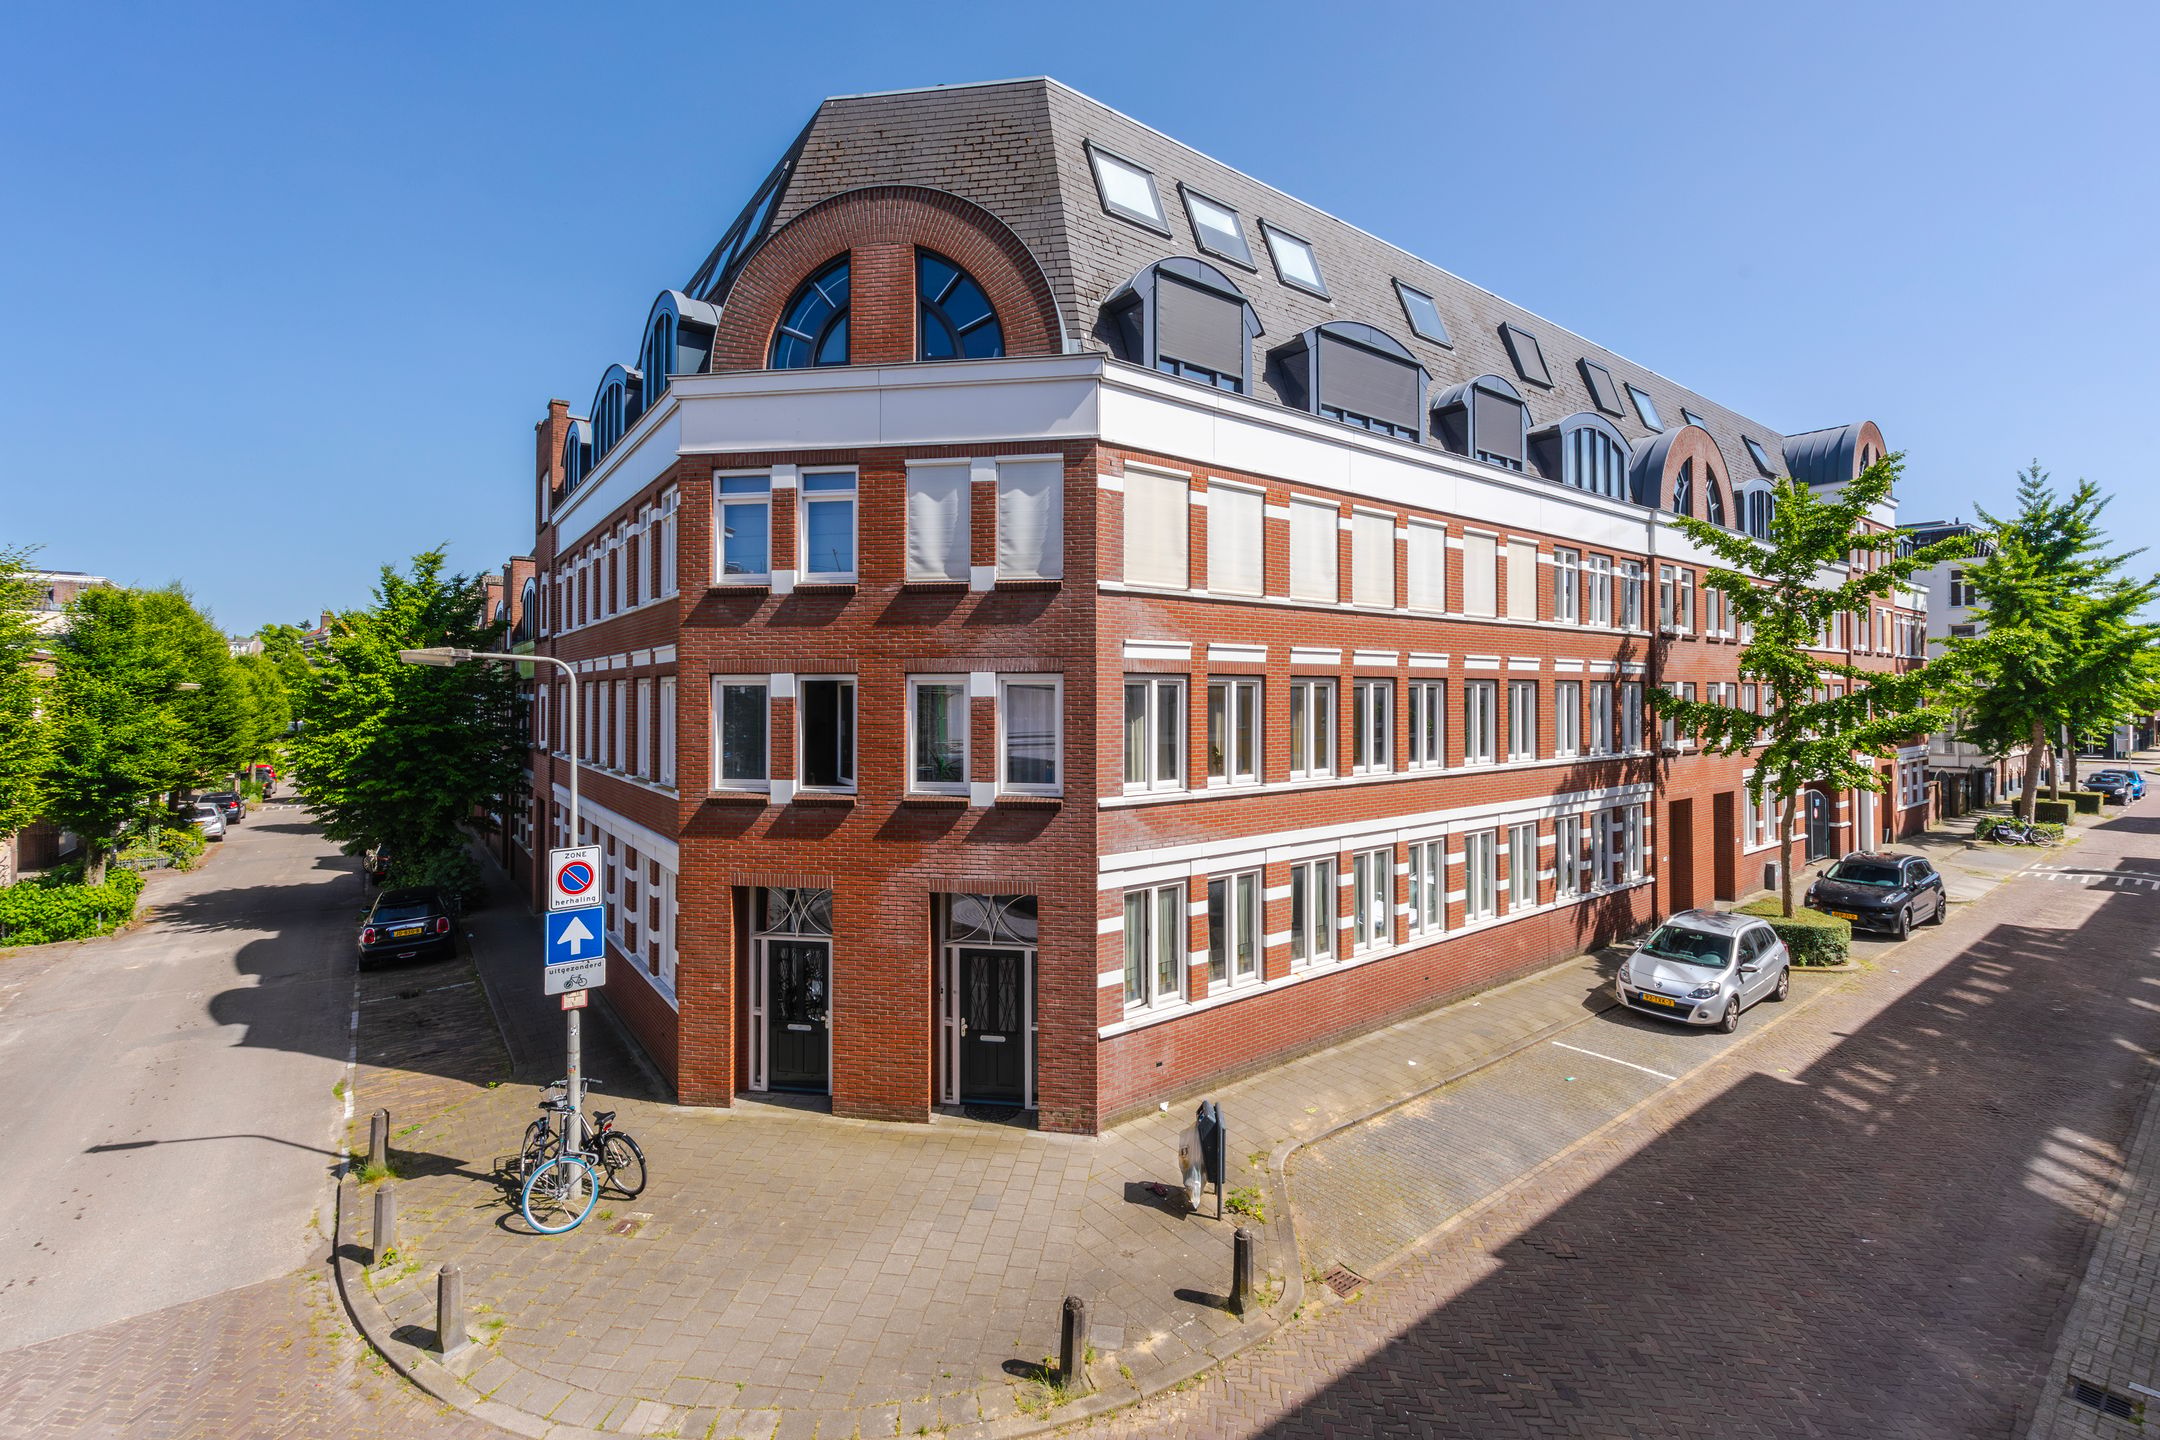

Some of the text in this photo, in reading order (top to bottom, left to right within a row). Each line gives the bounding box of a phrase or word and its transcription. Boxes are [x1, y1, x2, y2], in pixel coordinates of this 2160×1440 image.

[564, 851, 587, 859] ZONE
[555, 896, 596, 906] herhaling
[549, 961, 602, 975] uitgezonderd
